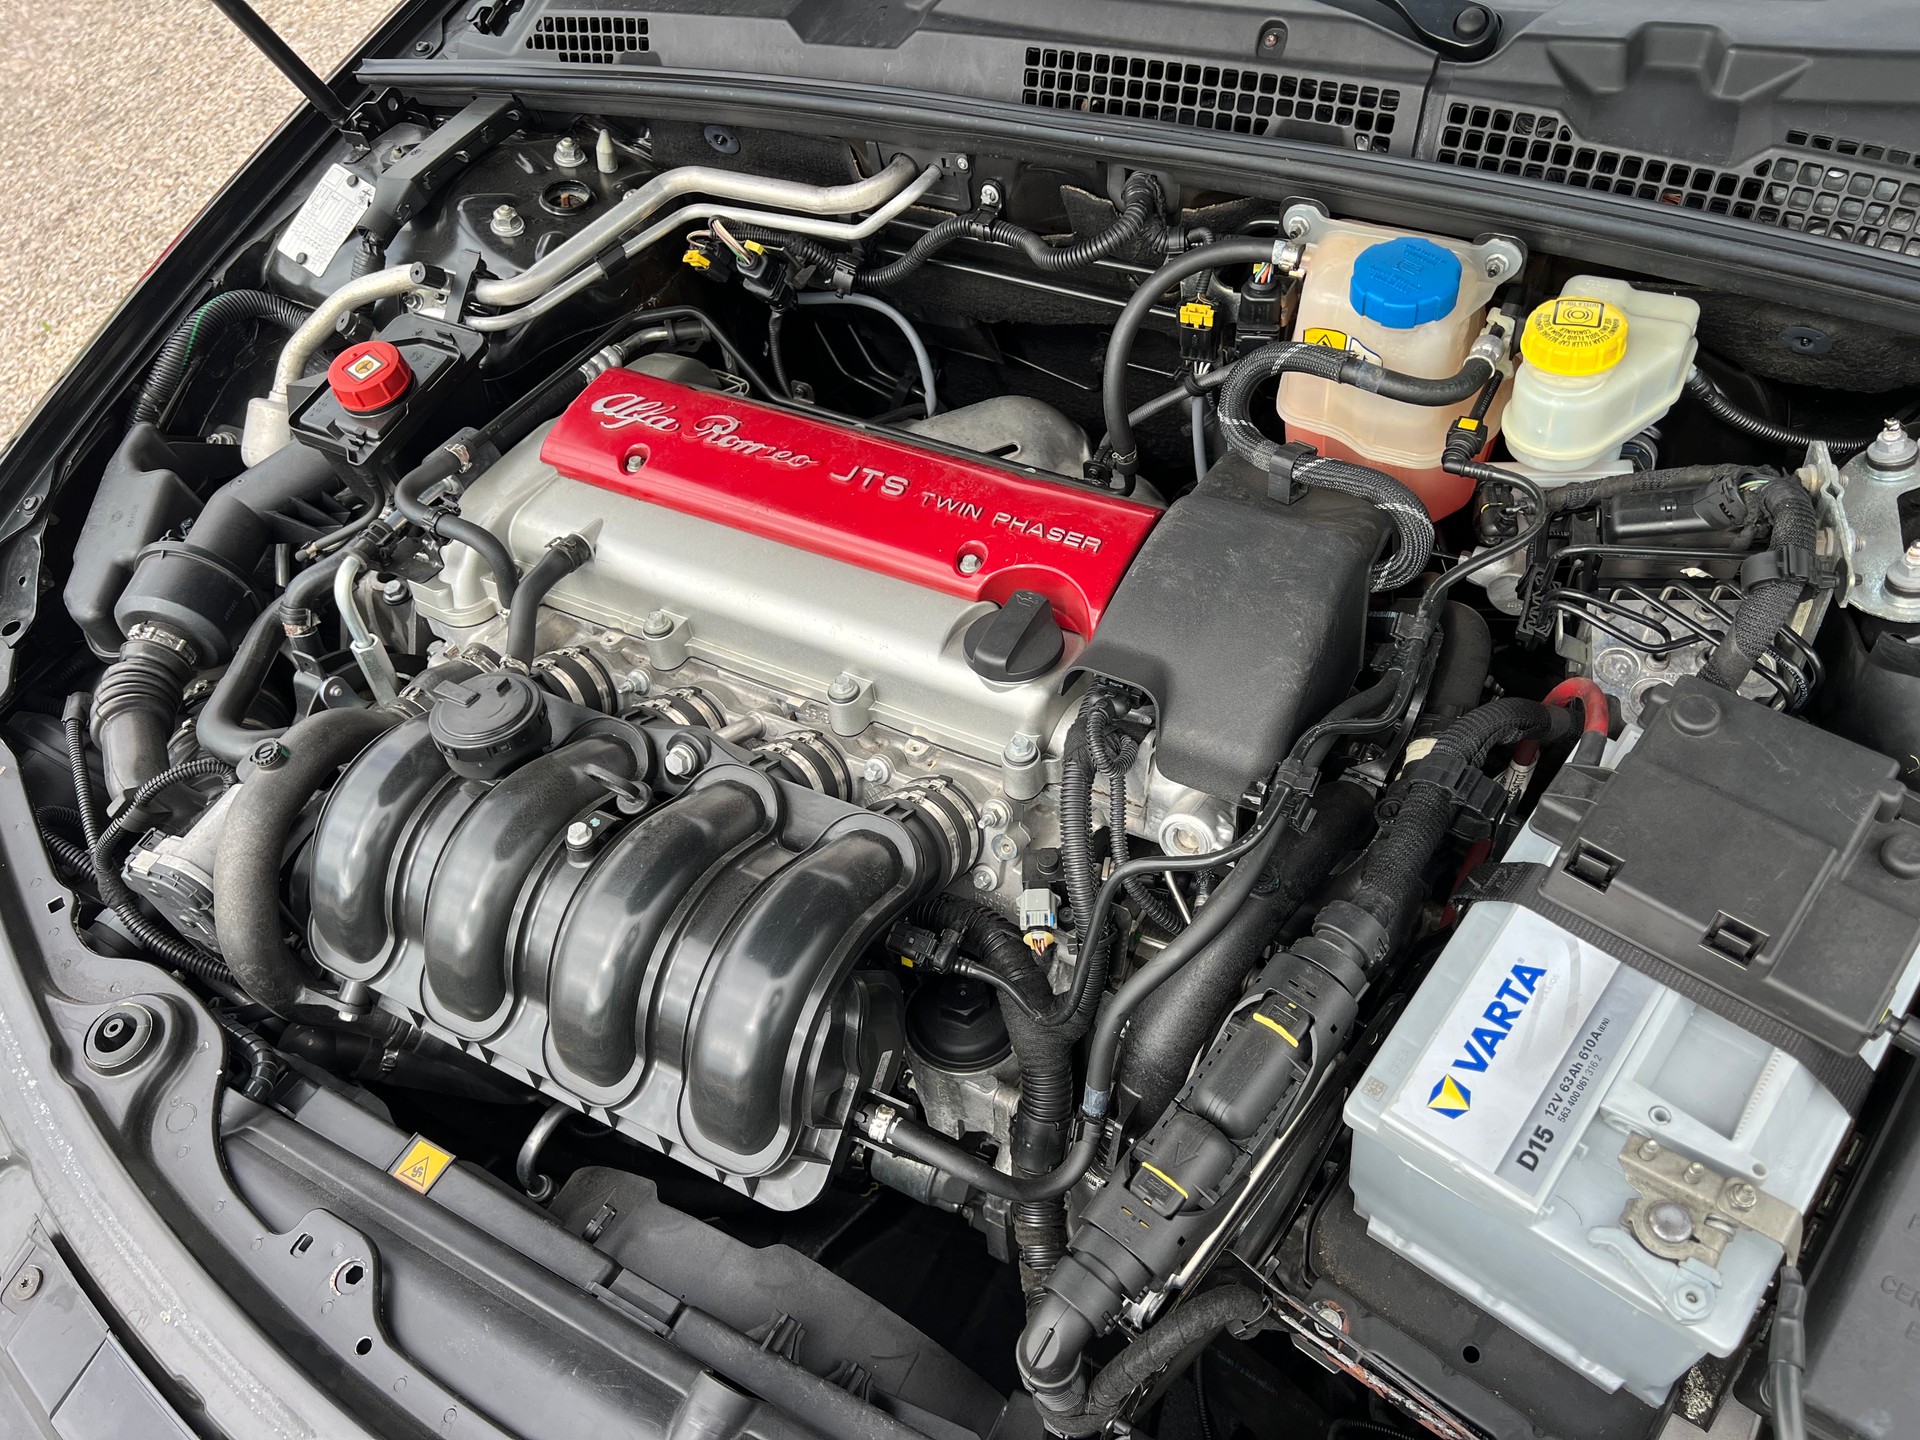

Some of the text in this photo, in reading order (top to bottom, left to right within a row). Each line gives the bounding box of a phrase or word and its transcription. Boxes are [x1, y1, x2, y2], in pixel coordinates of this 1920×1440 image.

[1541, 329, 1558, 344] BEFORE
[1550, 327, 1566, 339] FROM
[1561, 326, 1592, 336] CONTAINER
[1566, 334, 1585, 342] FLUID
[1559, 339, 1571, 347] CAP
[1572, 339, 1593, 348] FILLER
[1594, 333, 1610, 346] CLEAN
[591, 393, 681, 432] Alfa
[682, 414, 820, 467] Romeo
[829, 465, 1103, 553] JTS TWIN PHASER
[1451, 964, 1547, 1073] VARTA
[1544, 1092, 1564, 1117] 12V
[1559, 1061, 1583, 1092] 63Ah
[1558, 1054, 1602, 1123] 563 400 061 316 2
[1515, 1124, 1555, 1173] D15
